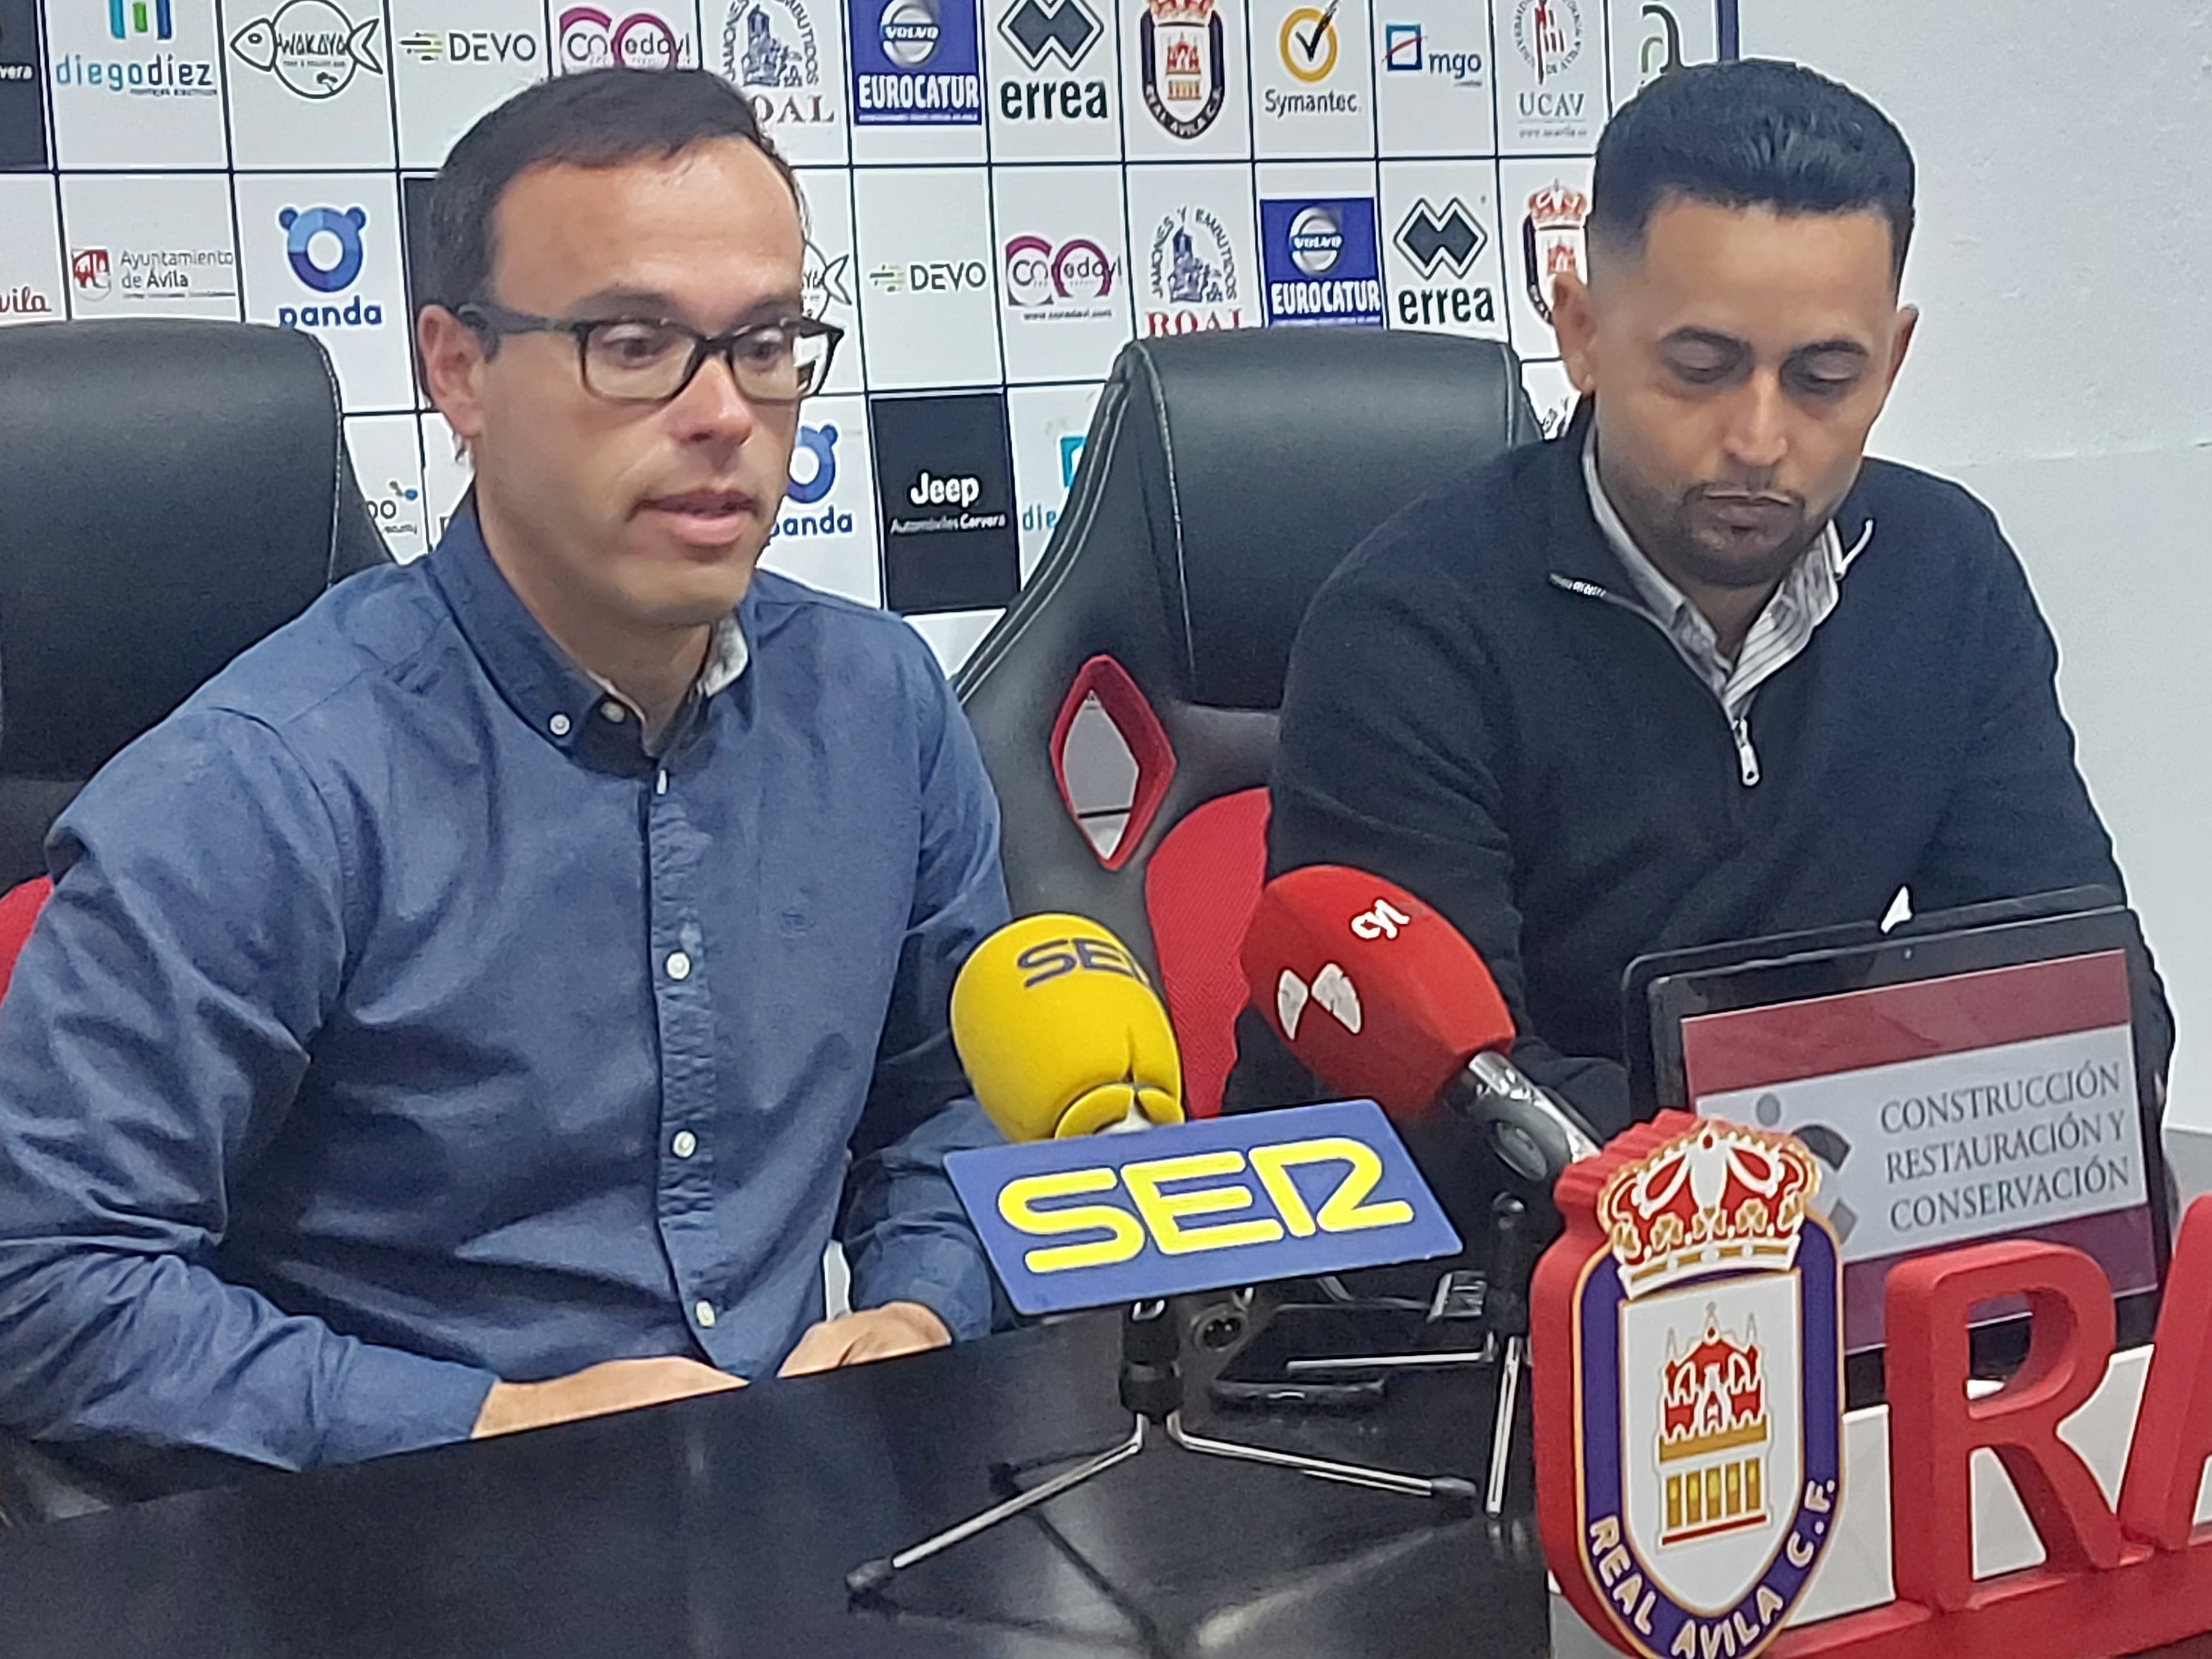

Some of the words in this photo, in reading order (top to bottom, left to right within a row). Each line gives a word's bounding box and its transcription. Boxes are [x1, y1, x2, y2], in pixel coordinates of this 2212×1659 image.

[449, 33, 536, 62] DEVO
[885, 27, 939, 39] VOLVO
[1428, 52, 1482, 79] mgo
[748, 94, 835, 123] OAL
[859, 75, 979, 109] EUROCATUR
[1519, 92, 1584, 116] UCAV
[120, 250, 233, 270] Ayuntamiento
[910, 262, 986, 291] DEVO
[122, 271, 142, 288] de
[279, 295, 382, 329] panda
[1271, 280, 1381, 314] EUROCATUR
[910, 472, 980, 508] Jeep
[768, 505, 852, 538] anda
[1880, 1059, 2120, 1134] CONSTRUCCIÓN
[1886, 1111, 2102, 1184] RESTAURACIÓN
[2107, 1108, 2125, 1141] Y
[997, 1137, 1415, 1273] SER
[1891, 1153, 2129, 1231] CONSERVACIÓN
[1590, 1515, 1657, 1636] REAL
[1670, 1586, 1784, 1659] AVILA
